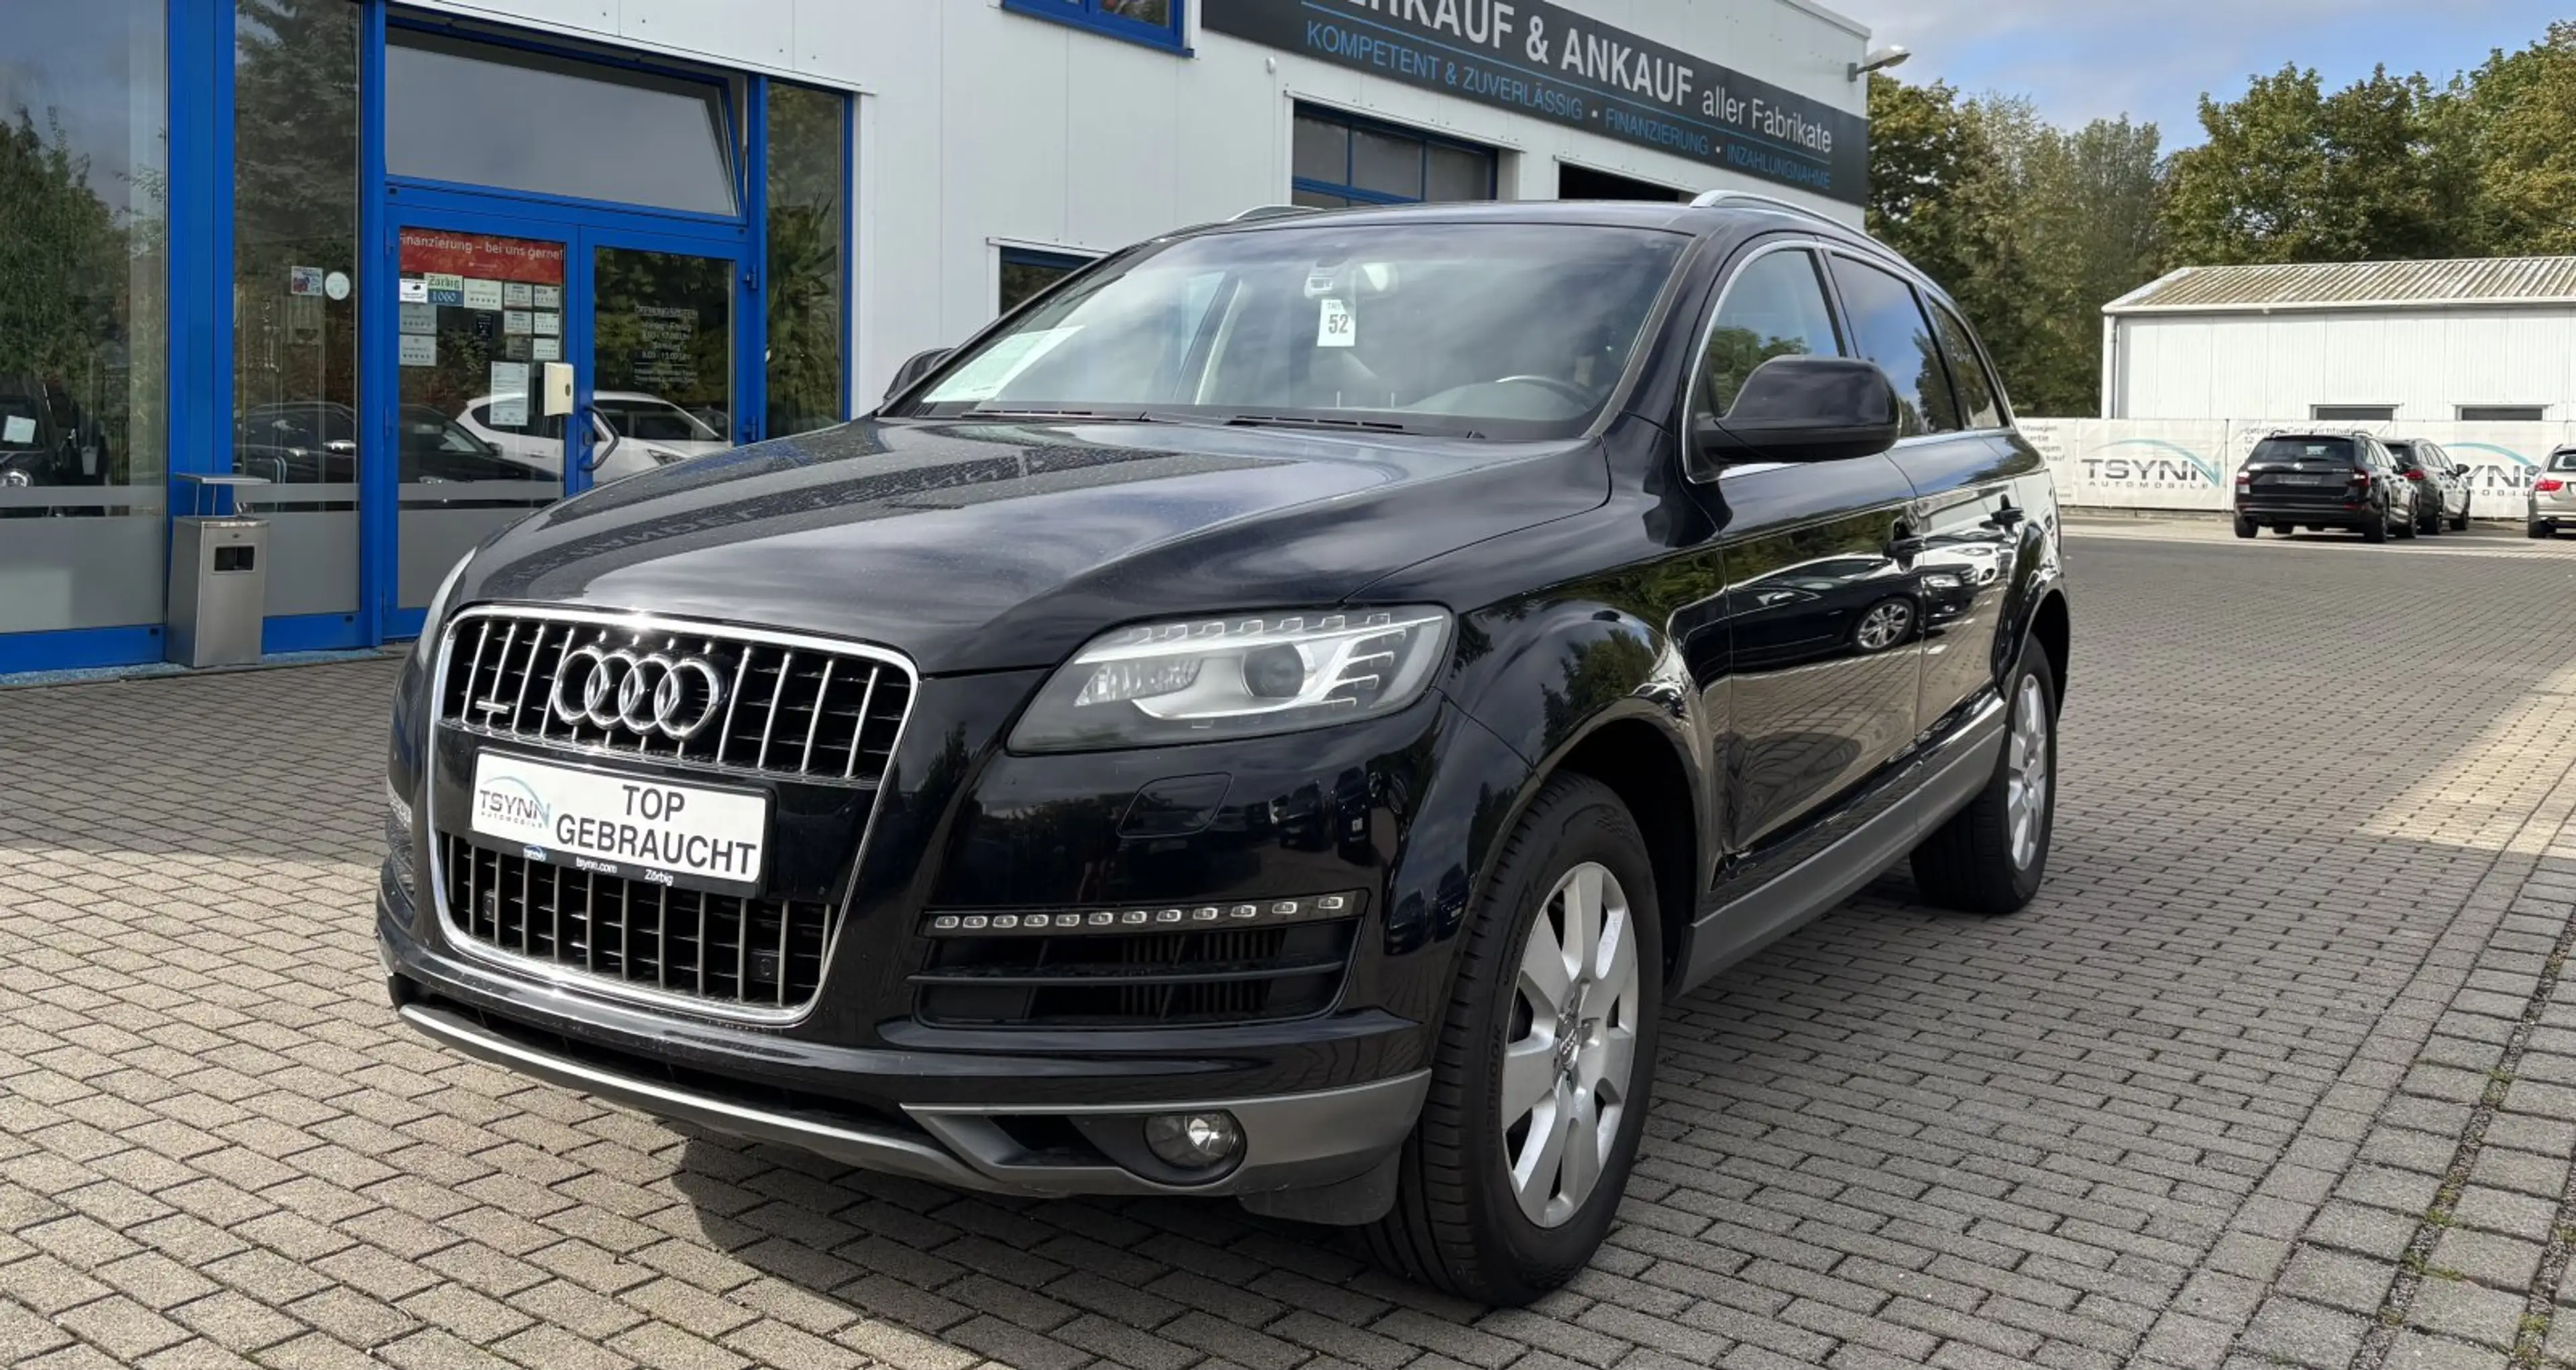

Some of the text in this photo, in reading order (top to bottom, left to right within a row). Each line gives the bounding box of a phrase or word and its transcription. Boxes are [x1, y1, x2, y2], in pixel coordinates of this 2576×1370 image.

[1306, 20, 1440, 81] KOMPETENT
[1445, 61, 1457, 86] &
[1462, 66, 1583, 120] ZUVERLÄSSIG
[1605, 107, 1709, 156] FINANZIERUNG
[1348, 0, 1833, 153] KAUF & ANKAUF aller Fabrikate
[485, 242, 502, 255] bei
[505, 246, 525, 256] uns
[1328, 313, 1348, 334] 52
[2081, 459, 2220, 486] TSYNN
[2088, 481, 2208, 489] AUTOMOBILE
[479, 789, 550, 827] TSYNN
[622, 784, 686, 822] TOP
[556, 813, 757, 875] GEBRAUCHT
